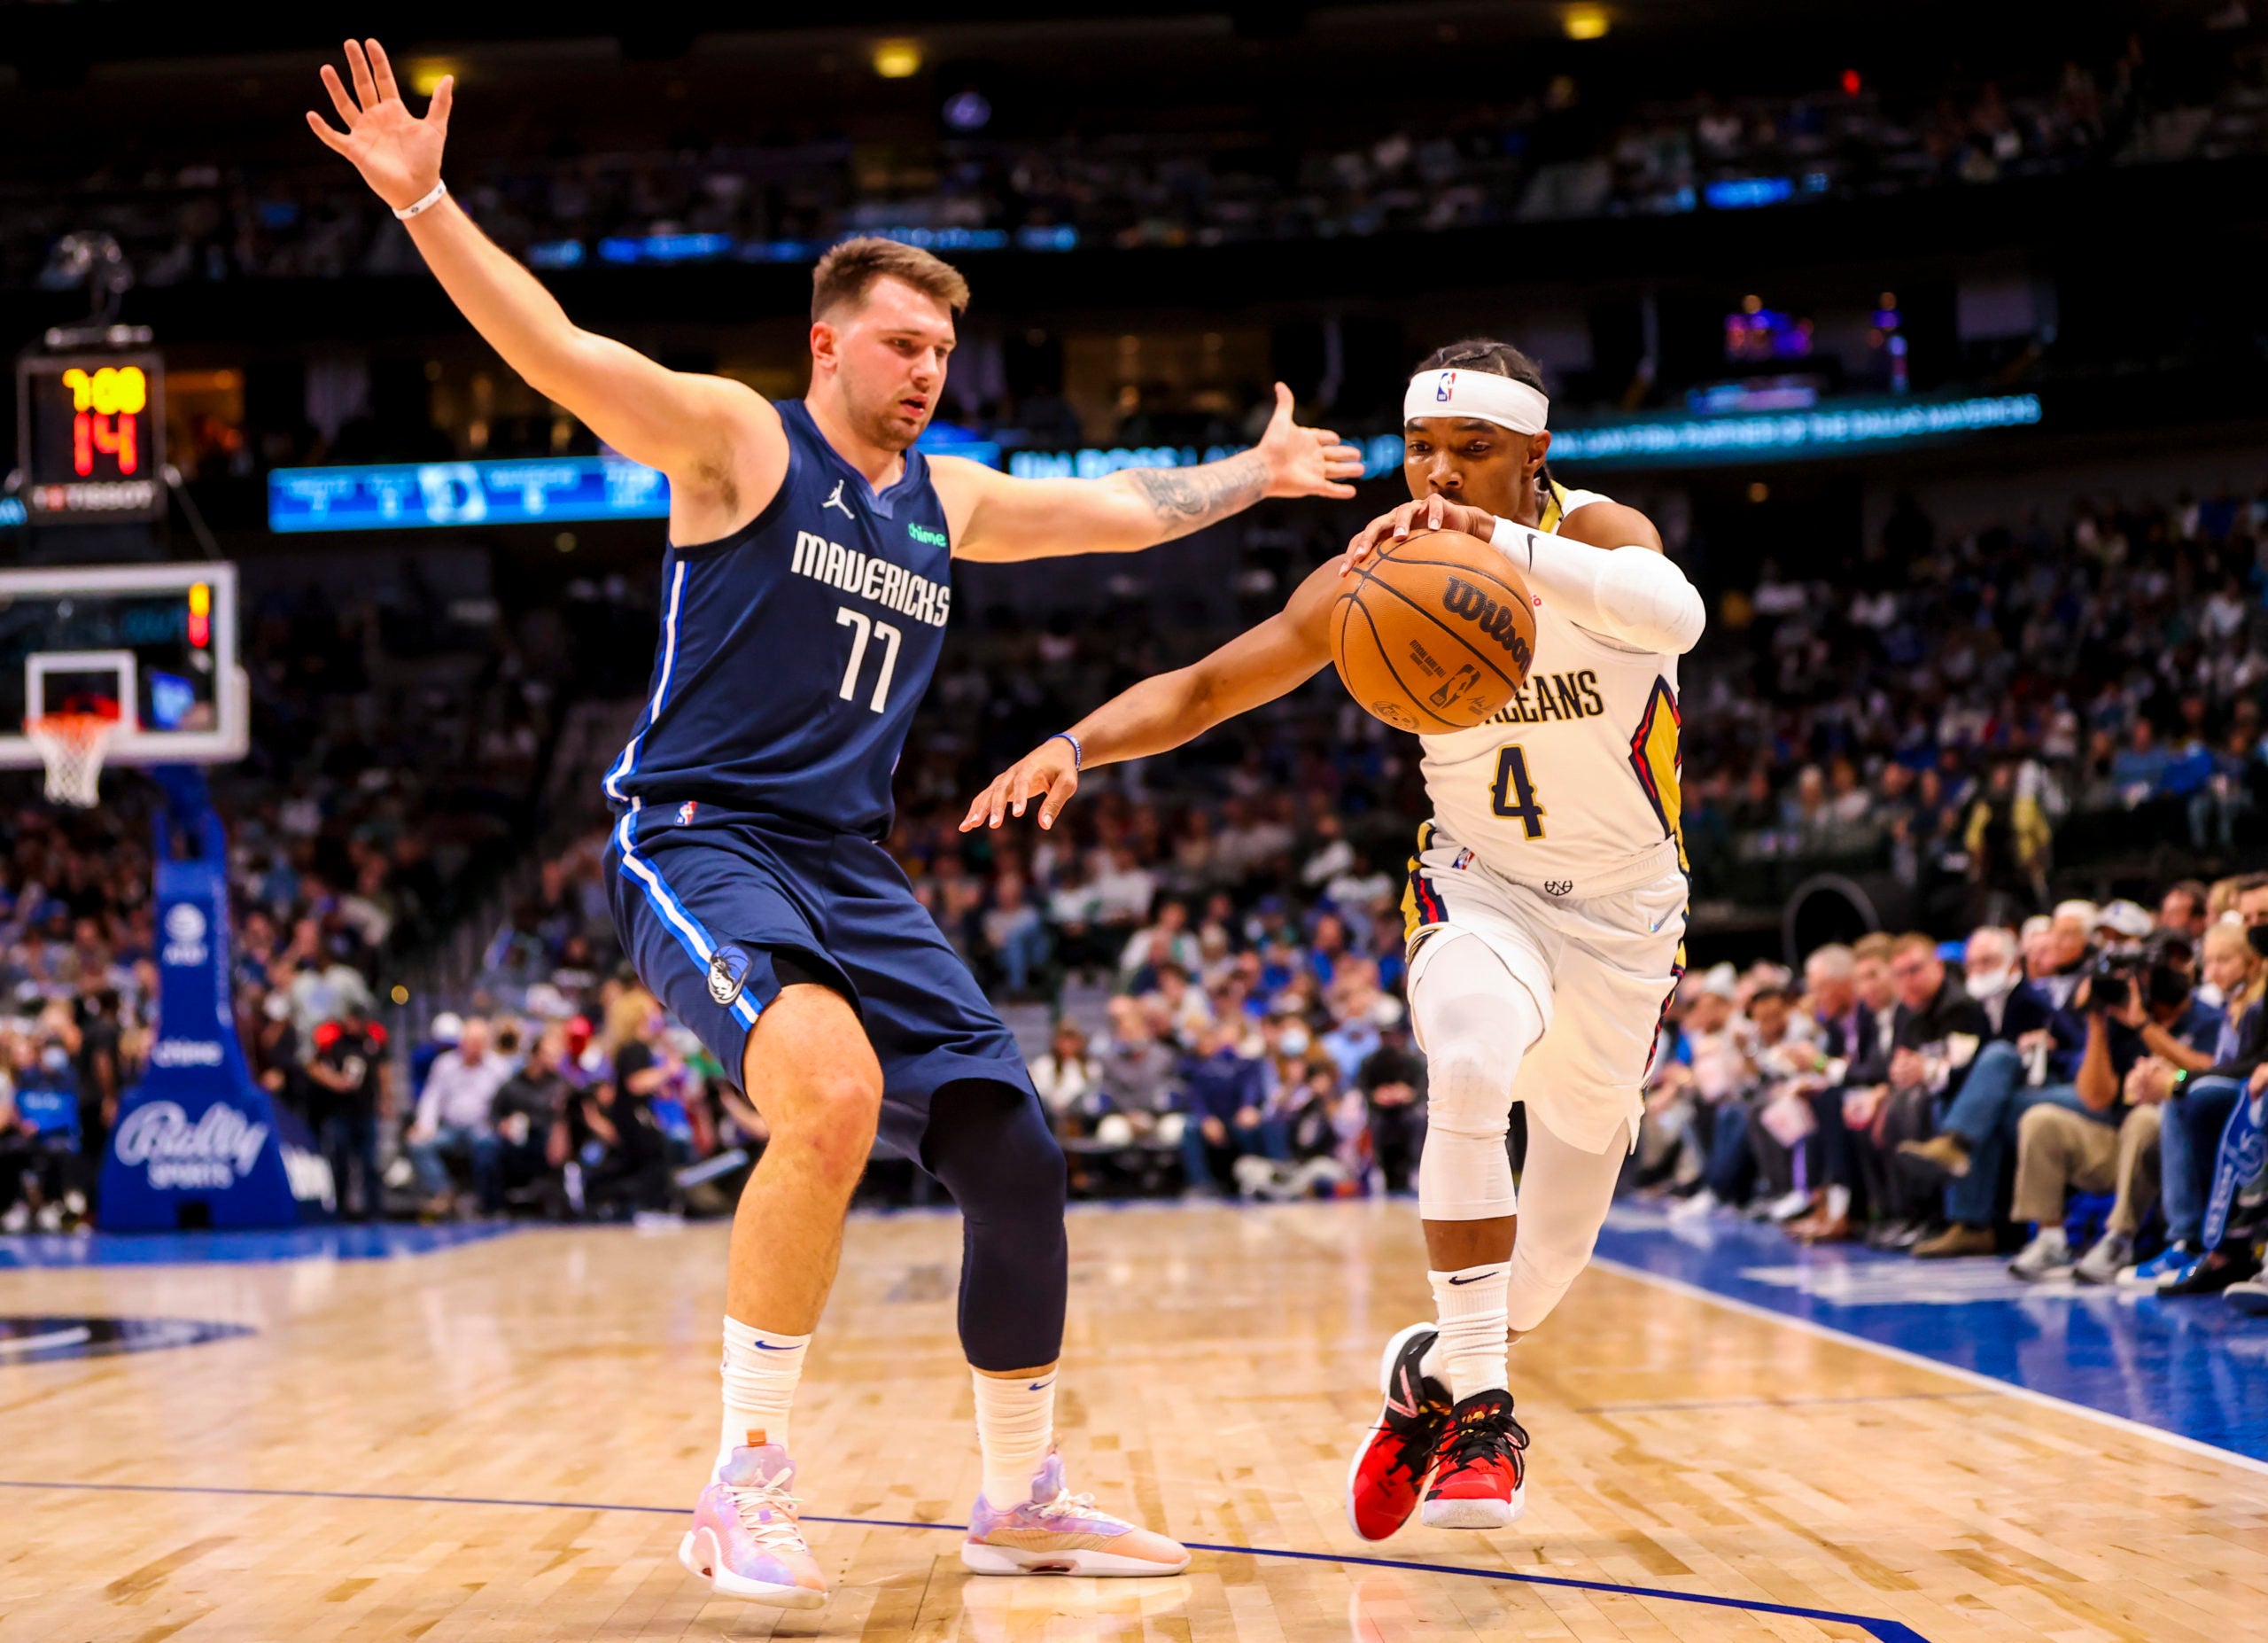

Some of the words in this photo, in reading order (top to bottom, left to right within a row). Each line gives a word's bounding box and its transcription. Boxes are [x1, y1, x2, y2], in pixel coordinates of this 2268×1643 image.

[74, 412, 137, 476] 14
[790, 529, 951, 627] MAVERICKS
[907, 521, 947, 548] chime
[835, 605, 902, 714] 77
[1442, 574, 1532, 679] Wilson
[1488, 743, 1548, 841] 4
[115, 1100, 268, 1178] Bally
